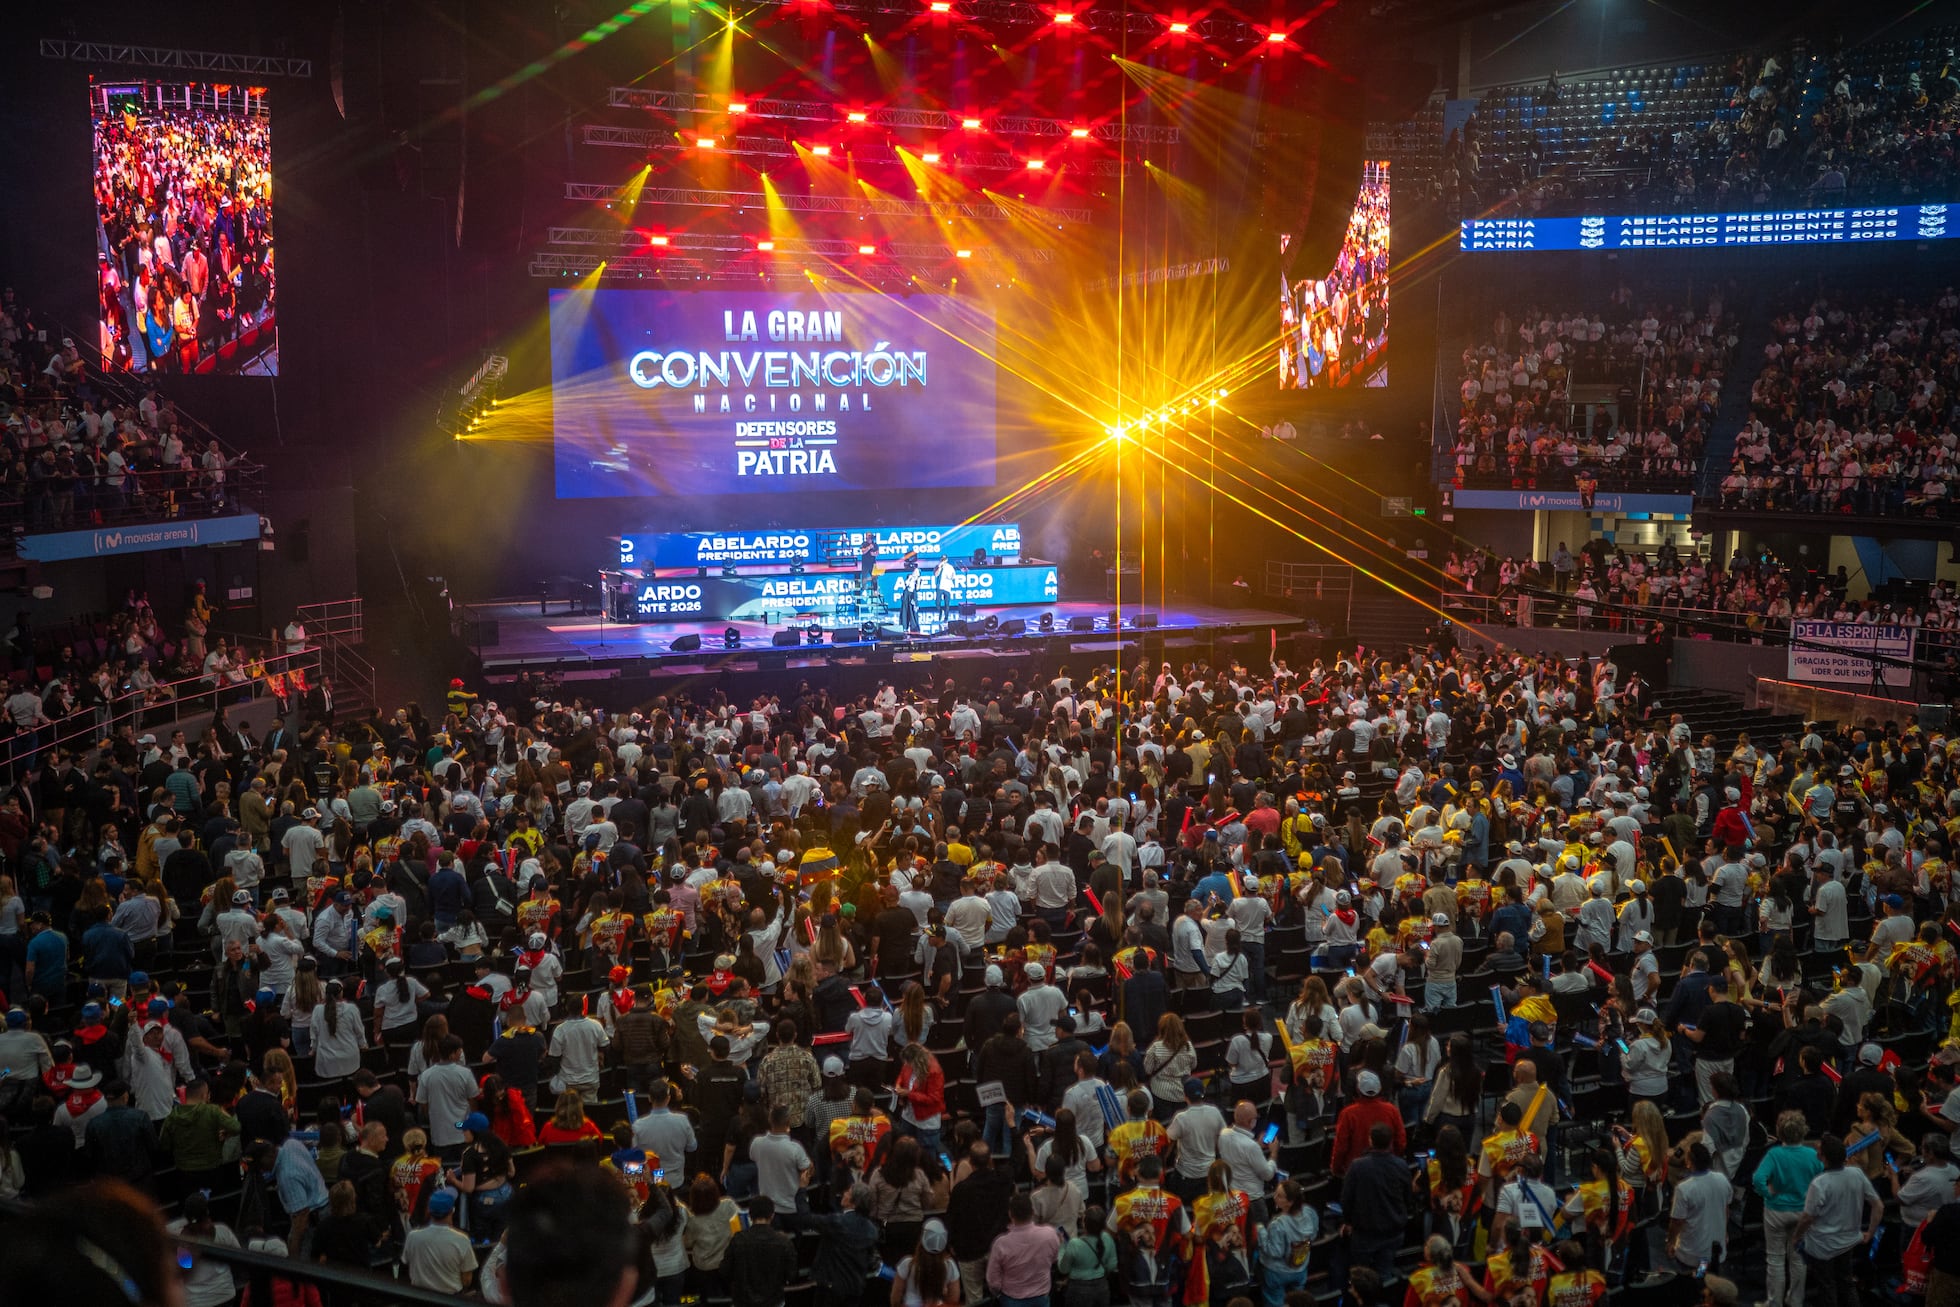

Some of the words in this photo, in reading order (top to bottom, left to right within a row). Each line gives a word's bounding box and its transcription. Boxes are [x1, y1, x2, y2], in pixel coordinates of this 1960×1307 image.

[1620, 215, 1719, 226] ABELARDO
[1725, 211, 1845, 223] PRESIDENTE
[1852, 209, 1898, 218] 2026
[1473, 220, 1535, 229] PATRIA
[1620, 225, 1718, 236] ABELARDO
[1725, 221, 1844, 233] PRESIDENTE
[1851, 219, 1897, 228] 2026
[1473, 230, 1535, 239] PATRIA
[1619, 236, 1718, 246] ABELARDO
[1724, 232, 1843, 244] PRESIDENTE
[1850, 230, 1896, 239] 2026
[1472, 240, 1534, 249] PATRIA
[724, 310, 759, 342] LA
[768, 310, 842, 342] GRAN
[629, 341, 928, 388] CONVENCIÓN
[694, 393, 873, 413] NACIONAL
[735, 421, 837, 437] DEFENSORES
[769, 437, 787, 449] DE
[789, 437, 804, 449] LA
[737, 449, 838, 476] PATRIA
[1547, 496, 1581, 506] movista
[124, 532, 162, 545] movistar
[164, 530, 188, 540] arena
[697, 535, 810, 551] ABELARDO
[836, 530, 941, 546] ABLARDO
[697, 550, 776, 561] PRESIDENTE
[778, 548, 810, 558] 2026
[912, 544, 941, 554] 2026
[638, 584, 702, 602] ARDO
[965, 588, 993, 600] 2026
[669, 601, 702, 612] 2026
[761, 595, 835, 608] PRESIDENTE
[1796, 624, 1813, 638] DE
[1816, 624, 1833, 638] LA
[1836, 625, 1909, 641] ESPRIELLA
[1832, 658, 1849, 667] POR
[1852, 660, 1865, 668] SER
[1834, 669, 1851, 677] QUE
[1132, 1197, 1169, 1206] FIRME
[1133, 1211, 1169, 1219] PATRIA
